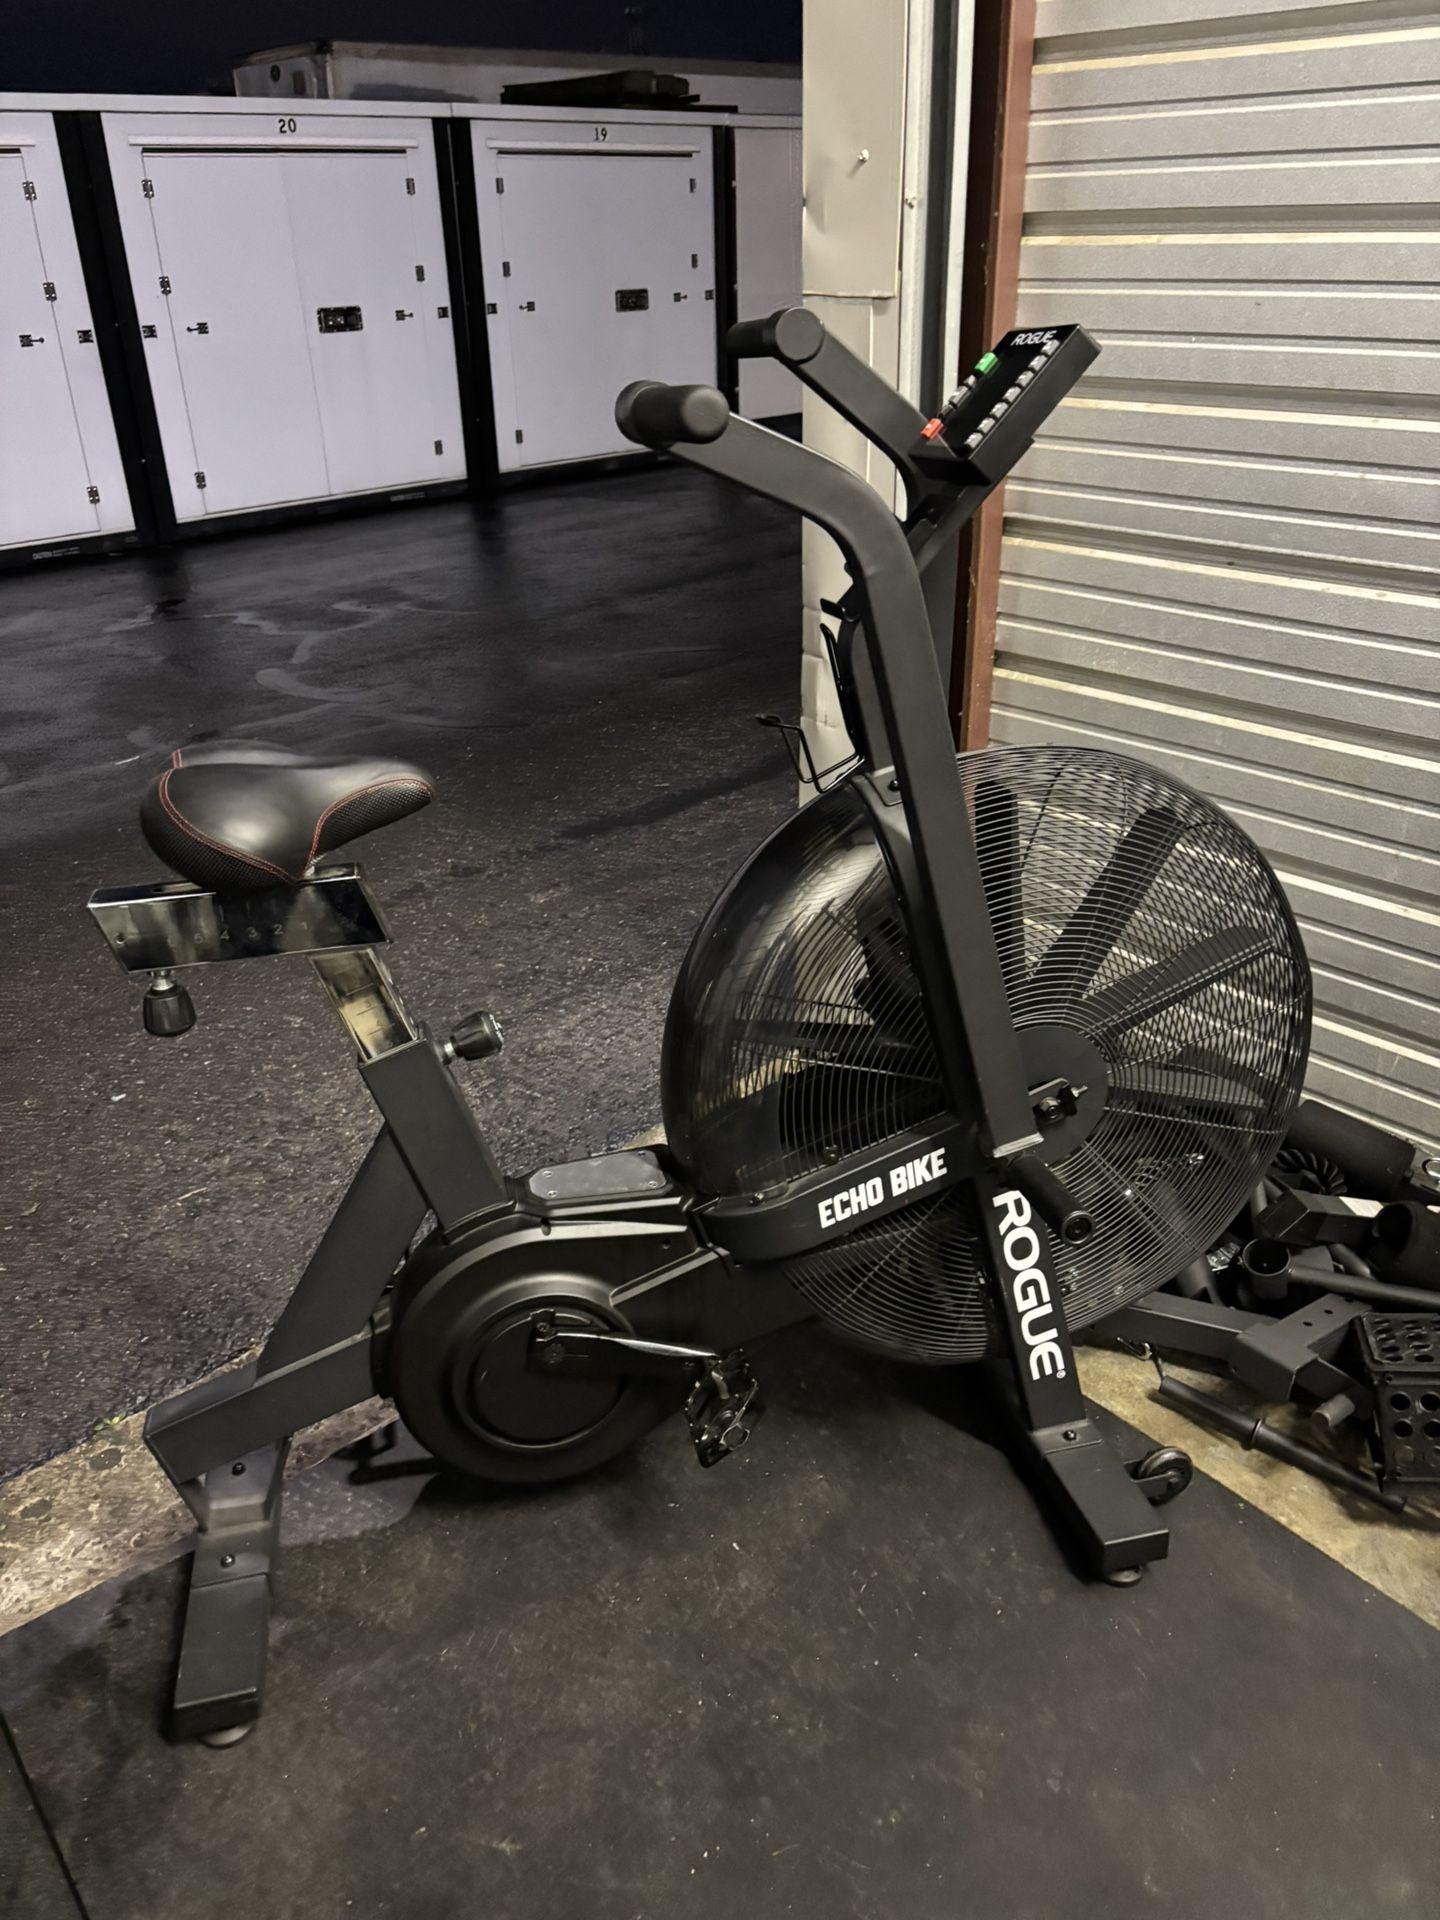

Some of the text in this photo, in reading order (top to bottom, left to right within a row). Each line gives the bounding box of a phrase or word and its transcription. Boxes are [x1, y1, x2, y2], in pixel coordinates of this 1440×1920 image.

[278, 118, 297, 134] 20
[594, 127, 608, 143] 19
[1010, 330, 1057, 346] ROGUE
[220, 929, 230, 941] 4
[247, 926, 258, 938] 3
[273, 923, 284, 935] 2
[818, 1147, 948, 1229] ECHO BIKE
